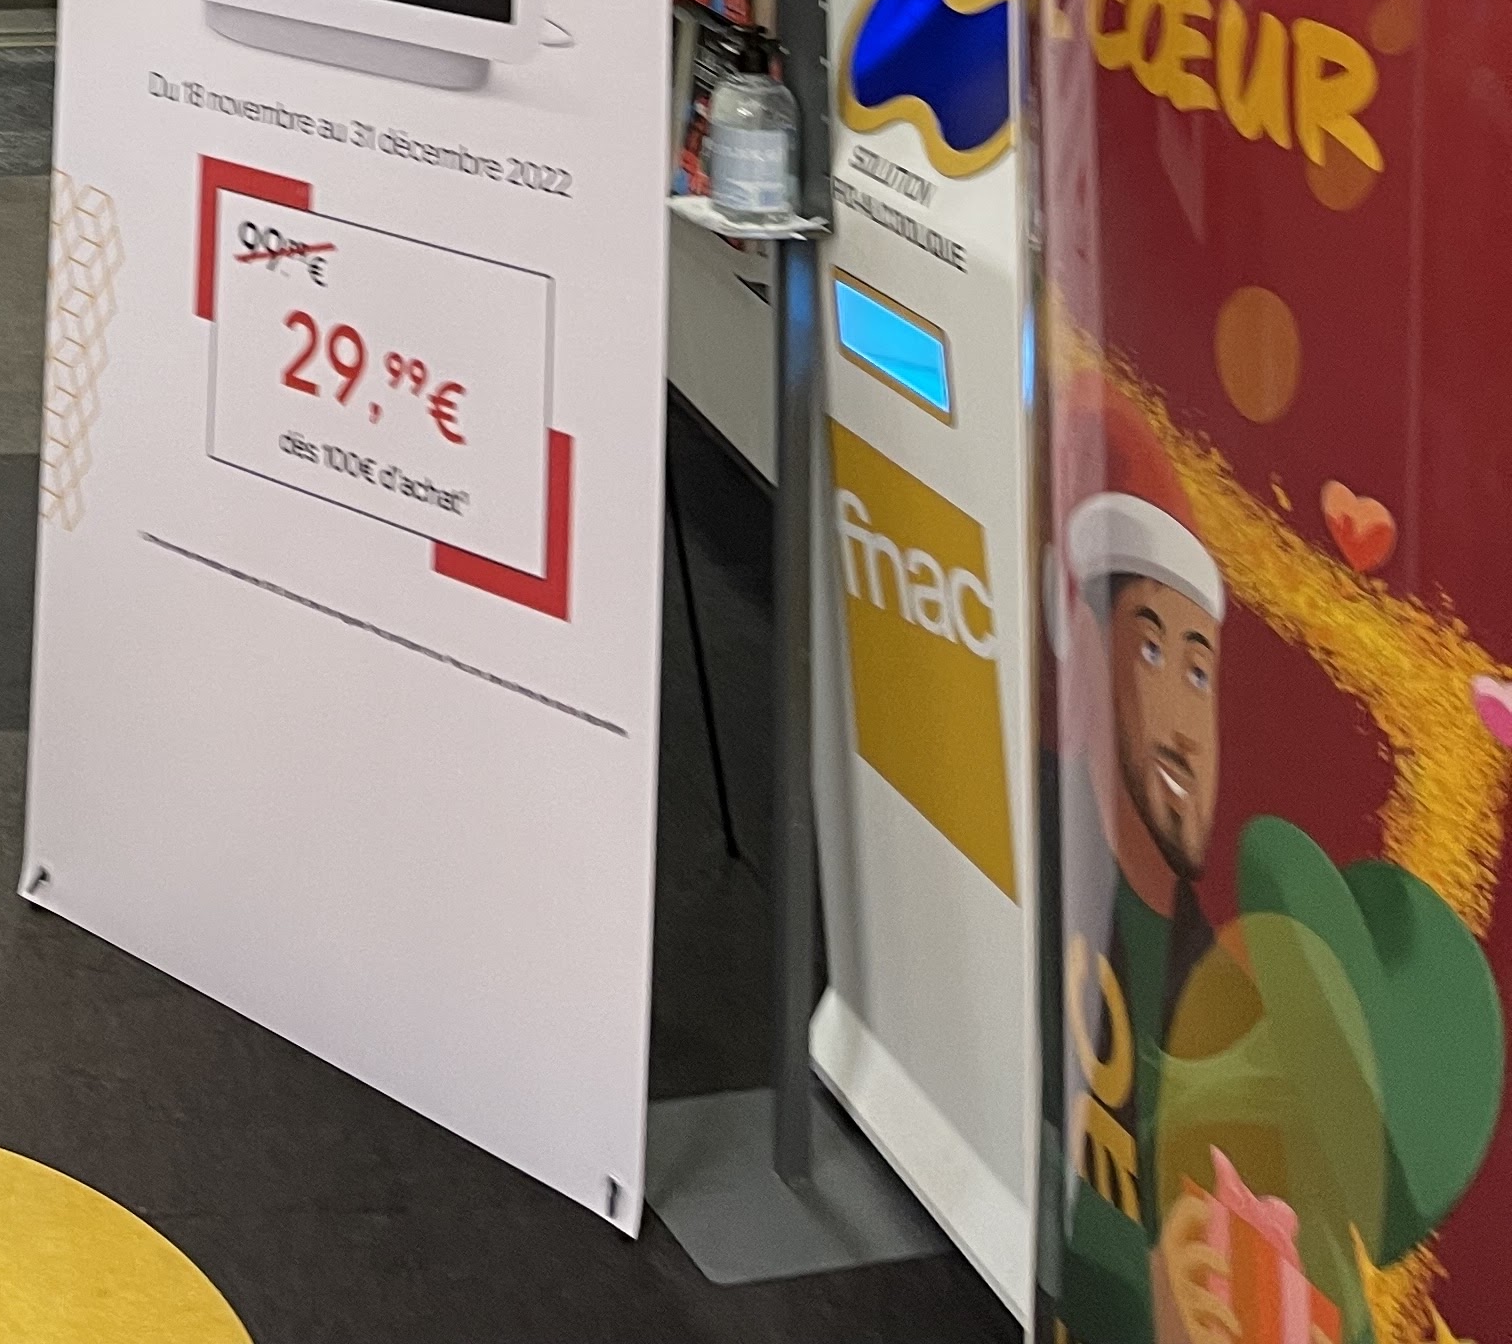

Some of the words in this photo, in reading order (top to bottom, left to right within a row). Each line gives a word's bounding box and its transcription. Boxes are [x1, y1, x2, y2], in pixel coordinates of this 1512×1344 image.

[148, 71, 180, 102] Du
[181, 81, 205, 108] 18
[206, 91, 316, 136] novembre
[317, 118, 348, 143] au
[350, 120, 376, 150] 31
[377, 127, 505, 182] décembre
[505, 157, 574, 199] 2022
[278, 429, 321, 464] dès
[320, 443, 379, 485] 100€
[836, 488, 998, 660] fnac
